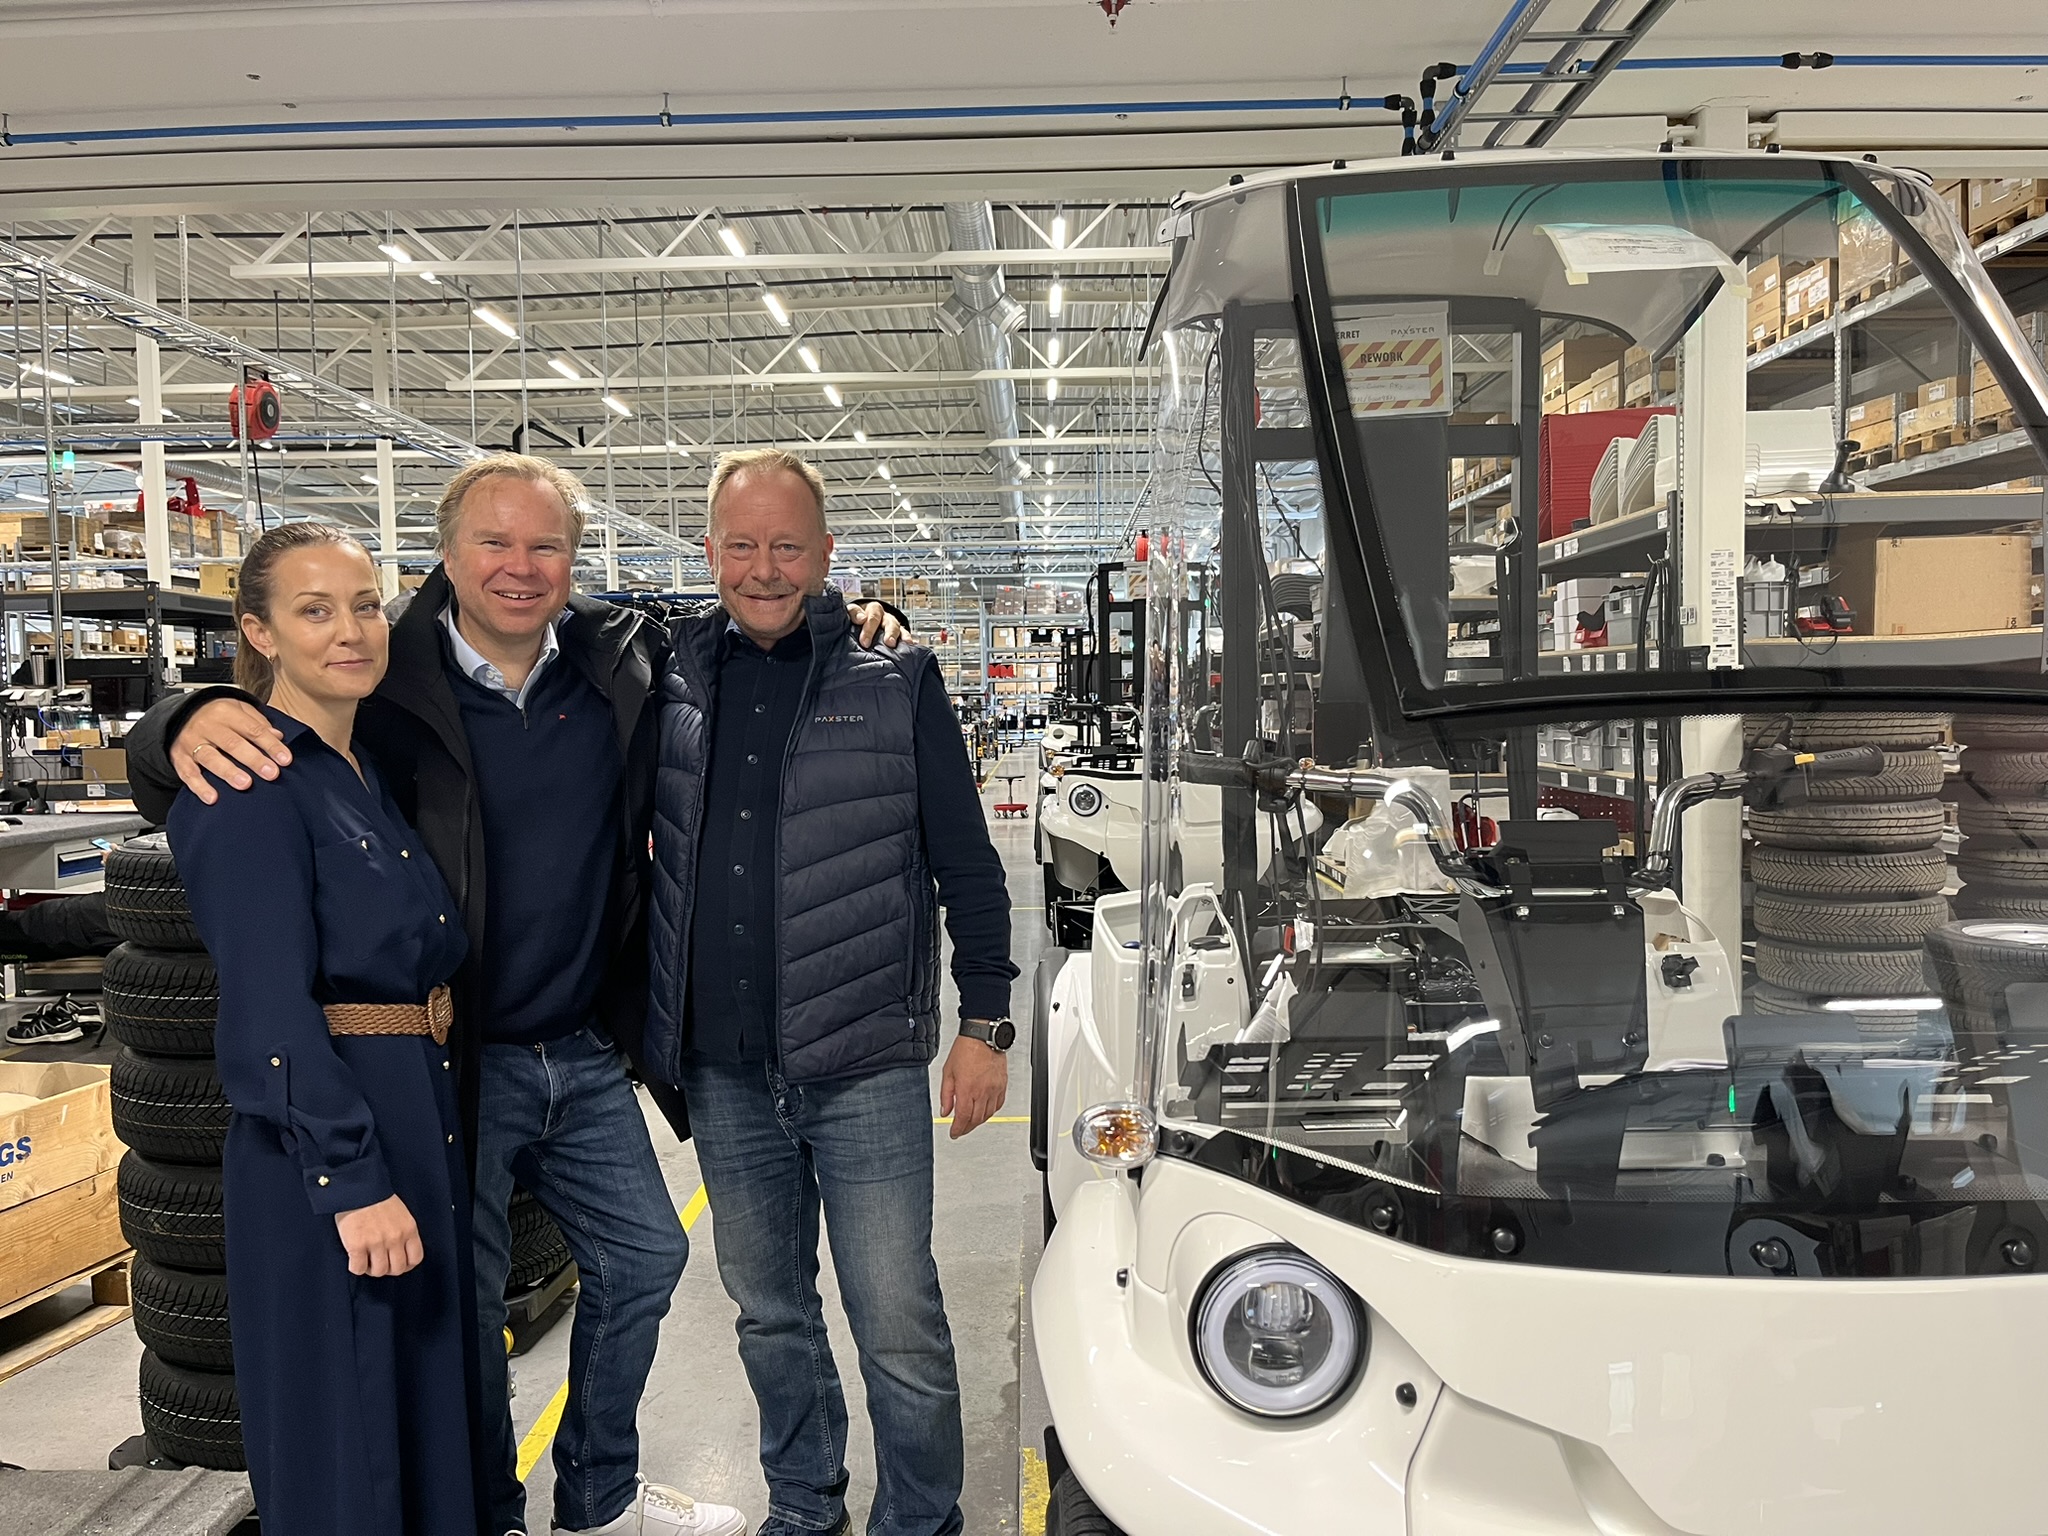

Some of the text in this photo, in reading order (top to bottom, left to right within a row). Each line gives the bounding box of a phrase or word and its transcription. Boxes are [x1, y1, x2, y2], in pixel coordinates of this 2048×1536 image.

[1390, 326, 1435, 338] PAXSTER
[1360, 351, 1403, 364] REWORK
[814, 715, 864, 724] PAXSTER
